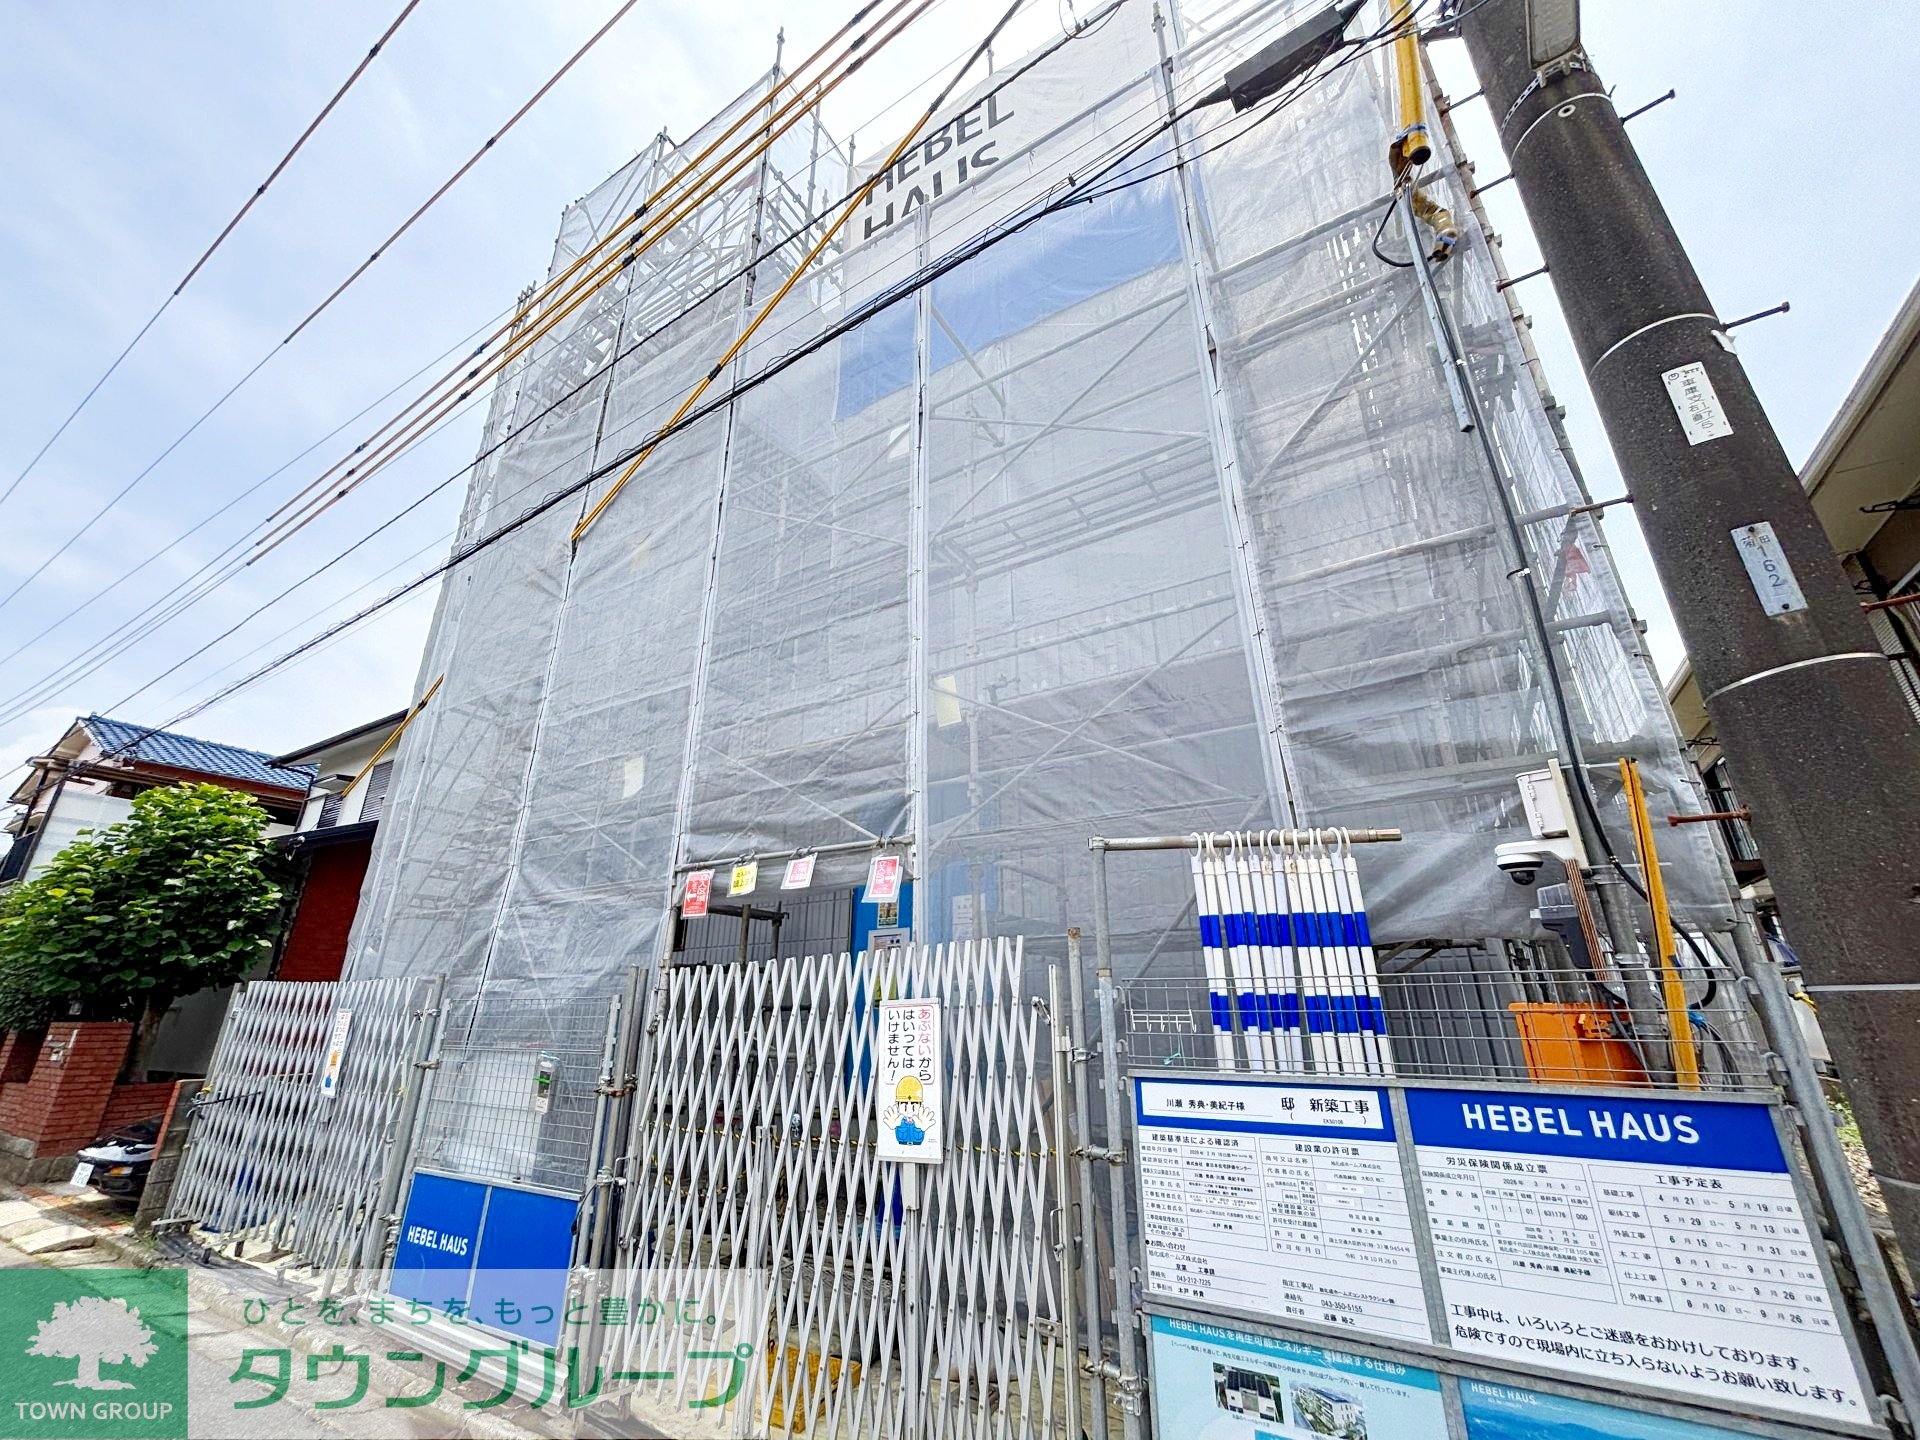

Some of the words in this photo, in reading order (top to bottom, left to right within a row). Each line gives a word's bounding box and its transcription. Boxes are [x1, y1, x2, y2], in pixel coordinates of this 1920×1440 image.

[865, 94, 1015, 207] HEBEL
[902, 1009, 915, 1069] はいっては
[918, 1008, 932, 1081] あぶないから
[1281, 1096, 1295, 1111] 邸
[1309, 1097, 1370, 1115] 新築工事
[1462, 1103, 1583, 1137] HEBEL
[1589, 1109, 1700, 1144] HAUS
[1151, 1133, 1239, 1147] 建築基準法による確認済
[1294, 1143, 1359, 1155] 建設業の許可票
[1445, 1156, 1548, 1173] 労災保険関係成立票
[1654, 1174, 1722, 1189] 工事予定表
[407, 1225, 438, 1249] HEBEL
[440, 1232, 469, 1256] HAUS
[1150, 1239, 1185, 1251] お問い合わせ
[1320, 1299, 1362, 1313] 043-350-5155
[1169, 1318, 1199, 1333] HEBEL
[1450, 1302, 1811, 1374] 工事中は、いろいろとご迷惑をおかけしております。
[1455, 1324, 1857, 1408] 危険ですので現場内に立ち入らないようお願い致します。
[1470, 1382, 1505, 1399] HEBEL
[1507, 1390, 1537, 1405] HAUS
